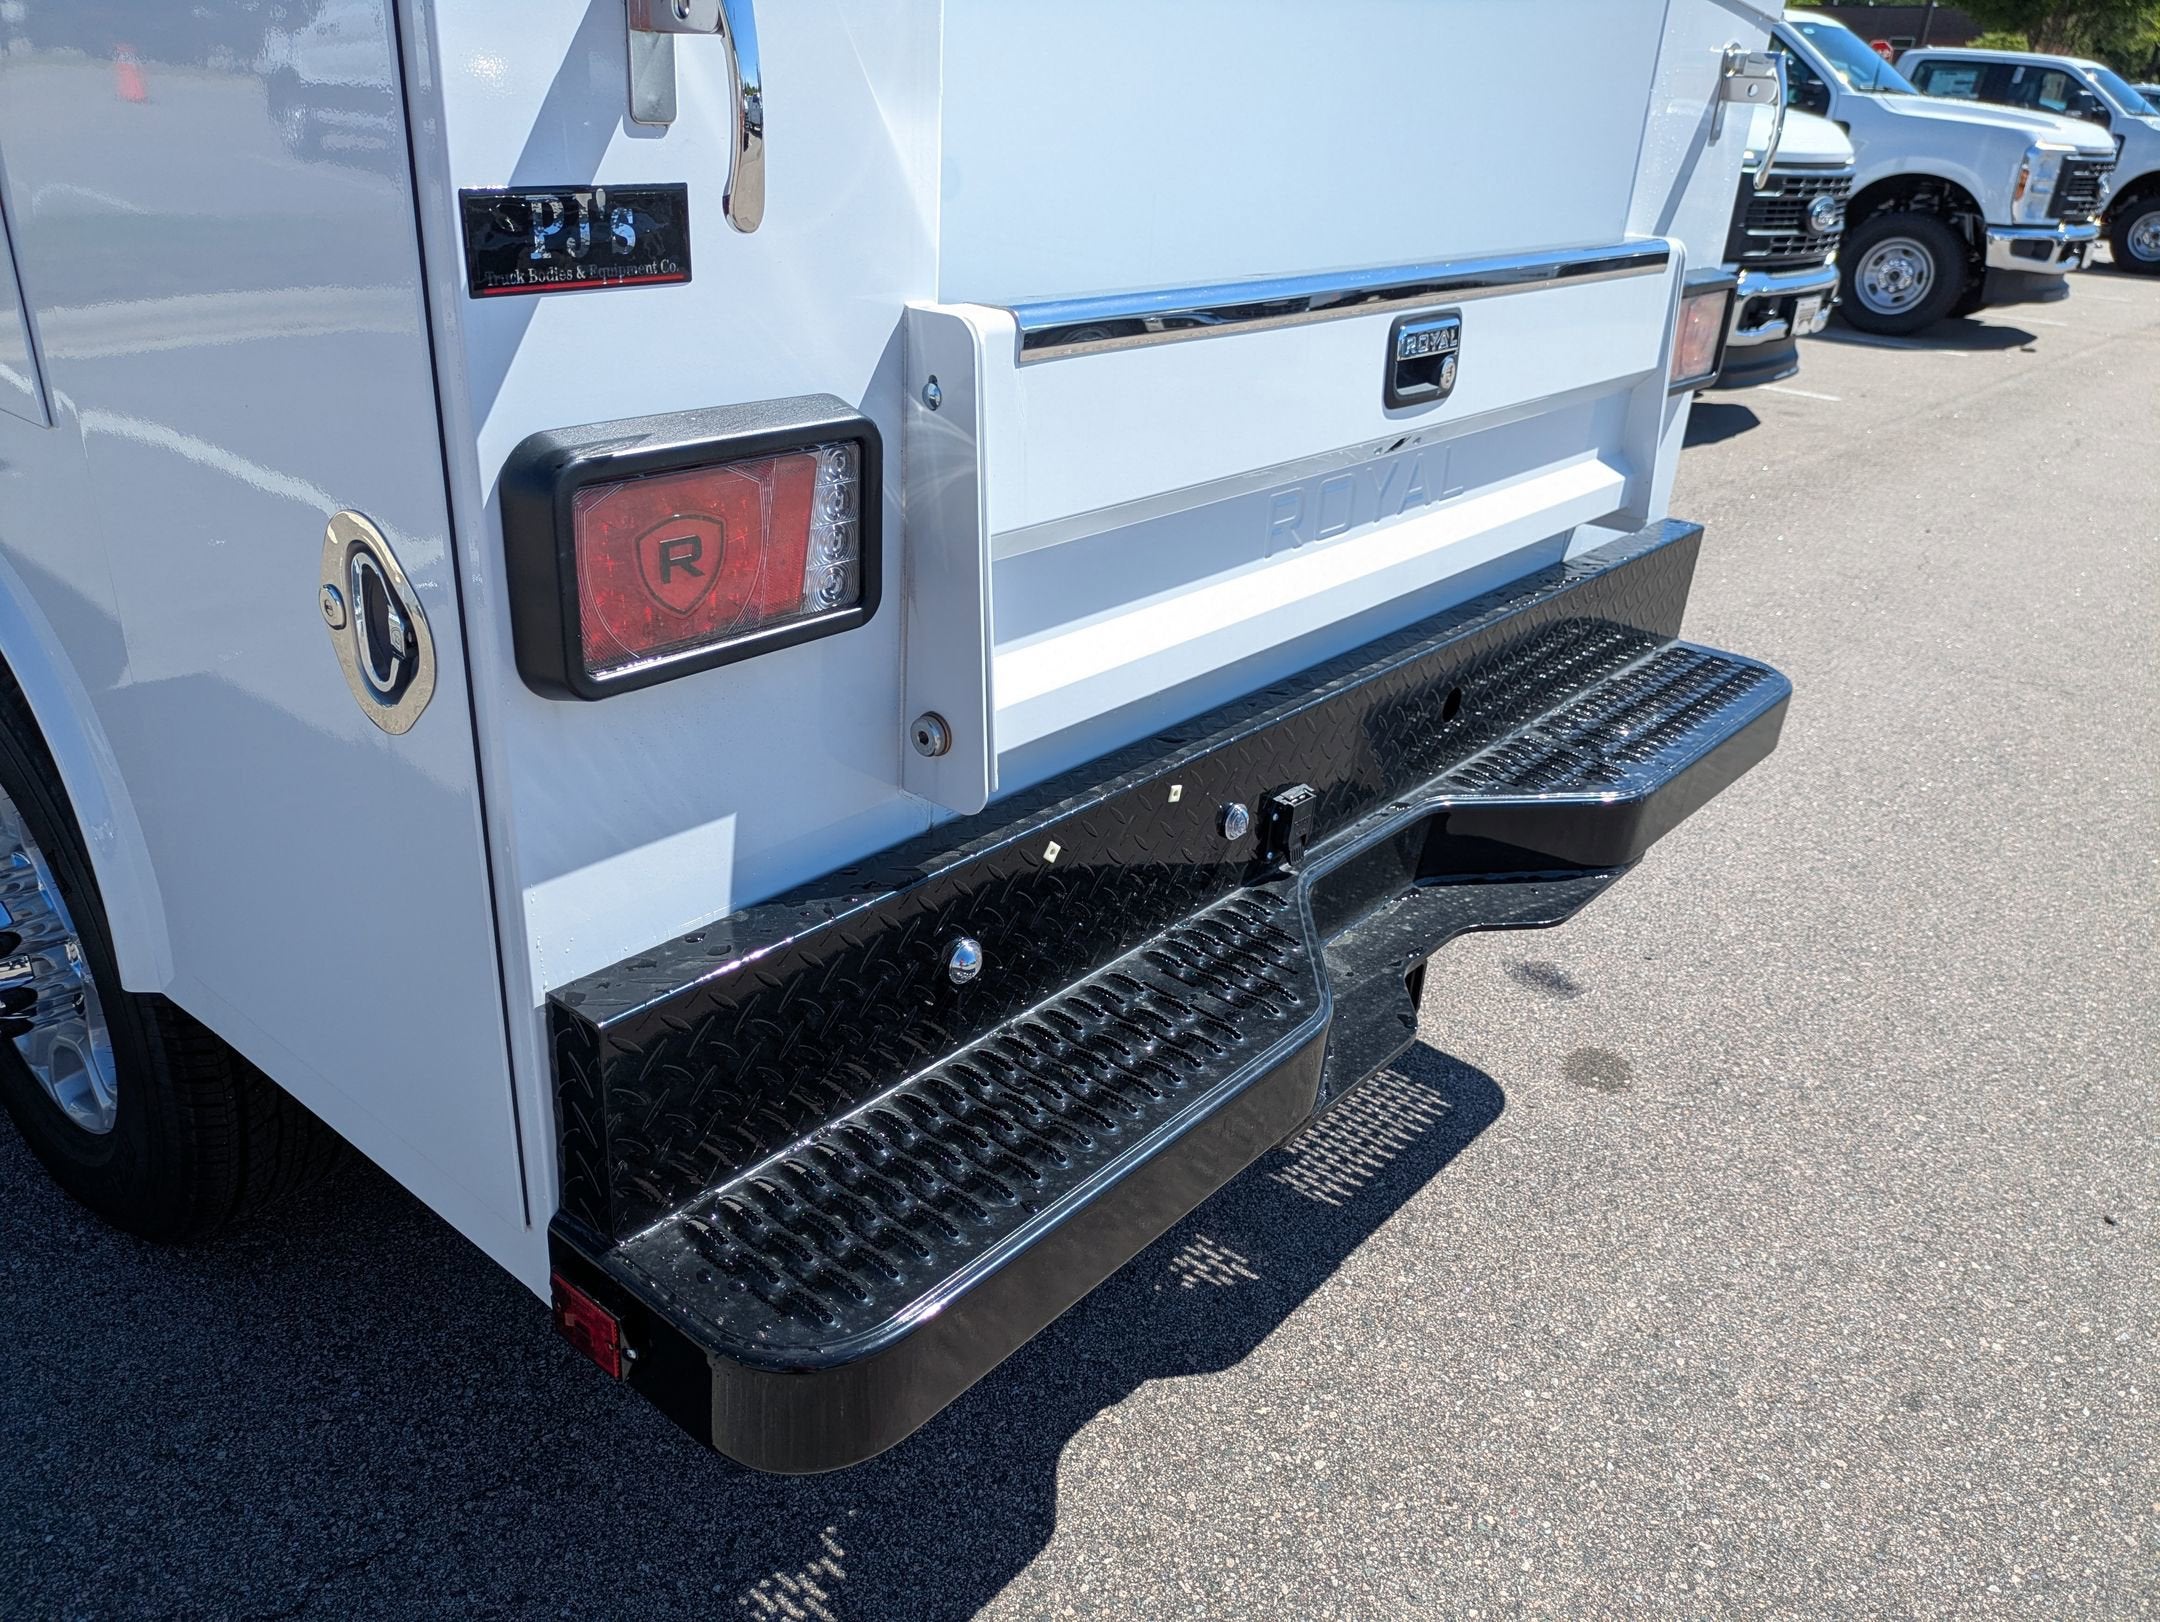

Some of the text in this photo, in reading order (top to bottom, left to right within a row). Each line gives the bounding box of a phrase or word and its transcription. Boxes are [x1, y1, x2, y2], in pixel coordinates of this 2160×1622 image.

[525, 187, 636, 260] PJ's
[485, 257, 680, 287] Truck Bodies & Equipment Co.
[1405, 328, 1458, 355] ROYAL
[1264, 446, 1464, 560] ROYAL
[660, 534, 705, 584] R
